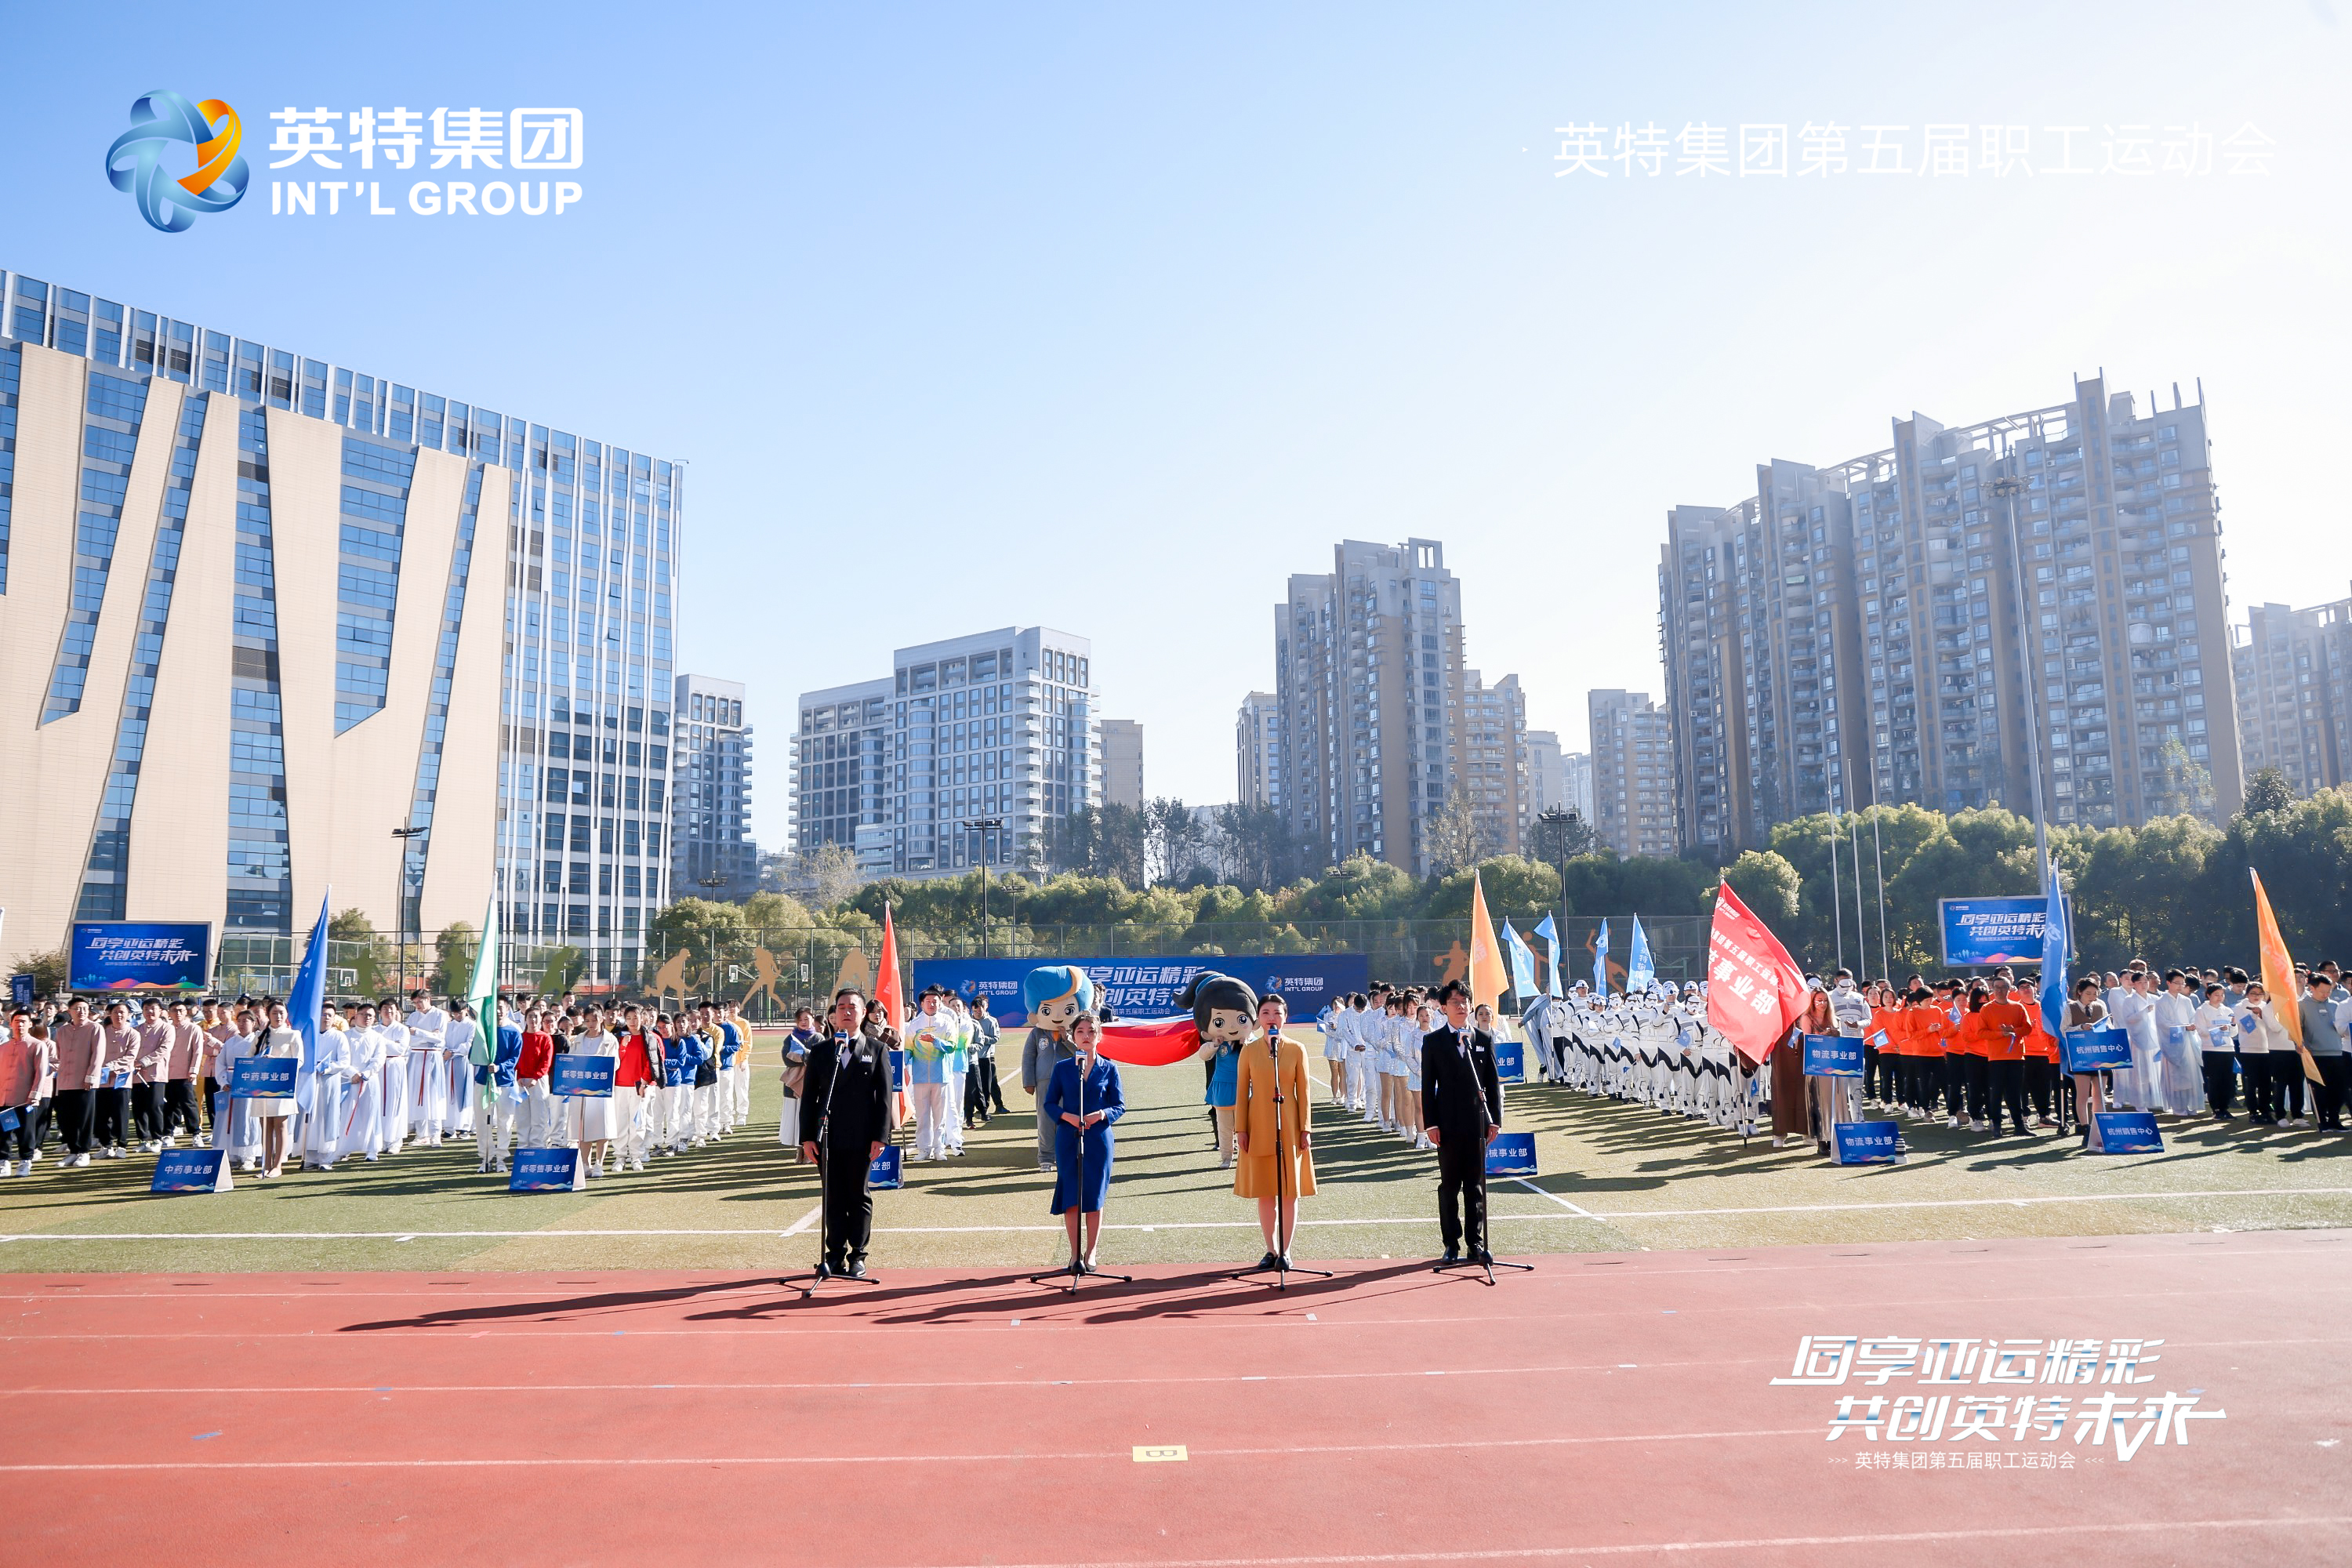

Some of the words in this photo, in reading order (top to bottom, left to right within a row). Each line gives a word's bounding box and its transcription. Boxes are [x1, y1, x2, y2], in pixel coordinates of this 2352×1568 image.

[1969, 924, 2045, 938] 共创英特未
[85, 938, 185, 949] 同享亚运精彩
[98, 949, 198, 965] 共创英特未来
[1080, 965, 1207, 985] 享亚运精彩
[978, 981, 1018, 990] 英特集团
[1284, 977, 1323, 986] 英特集团
[2076, 1044, 2124, 1054] 杭州销售中心
[1812, 1049, 1857, 1060] 物流事业部
[241, 1072, 289, 1081] 中药事业部
[561, 1070, 608, 1080] 新零售事业部
[2107, 1127, 2154, 1136] 杭州销售中心
[1845, 1136, 1893, 1146] 物流事业部
[1486, 1148, 1528, 1158] 械事业部
[165, 1165, 213, 1174] 中药事业部
[520, 1164, 570, 1174] 新零售事业部
